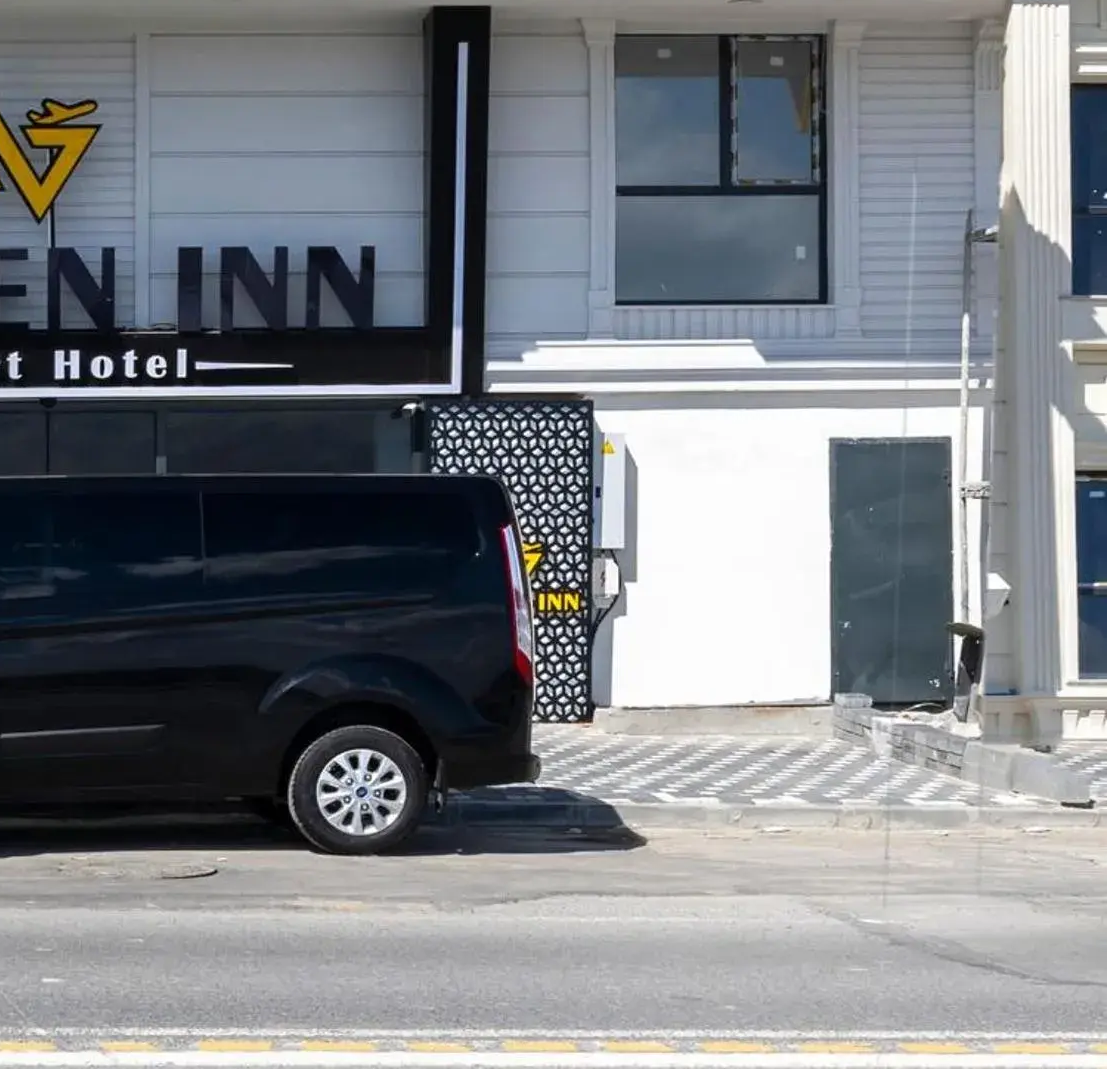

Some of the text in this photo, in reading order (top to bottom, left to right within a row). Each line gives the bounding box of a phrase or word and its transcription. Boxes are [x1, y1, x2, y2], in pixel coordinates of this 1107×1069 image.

[177, 245, 376, 332] INN
[53, 348, 188, 380] Hotel
[537, 592, 580, 611] INN
